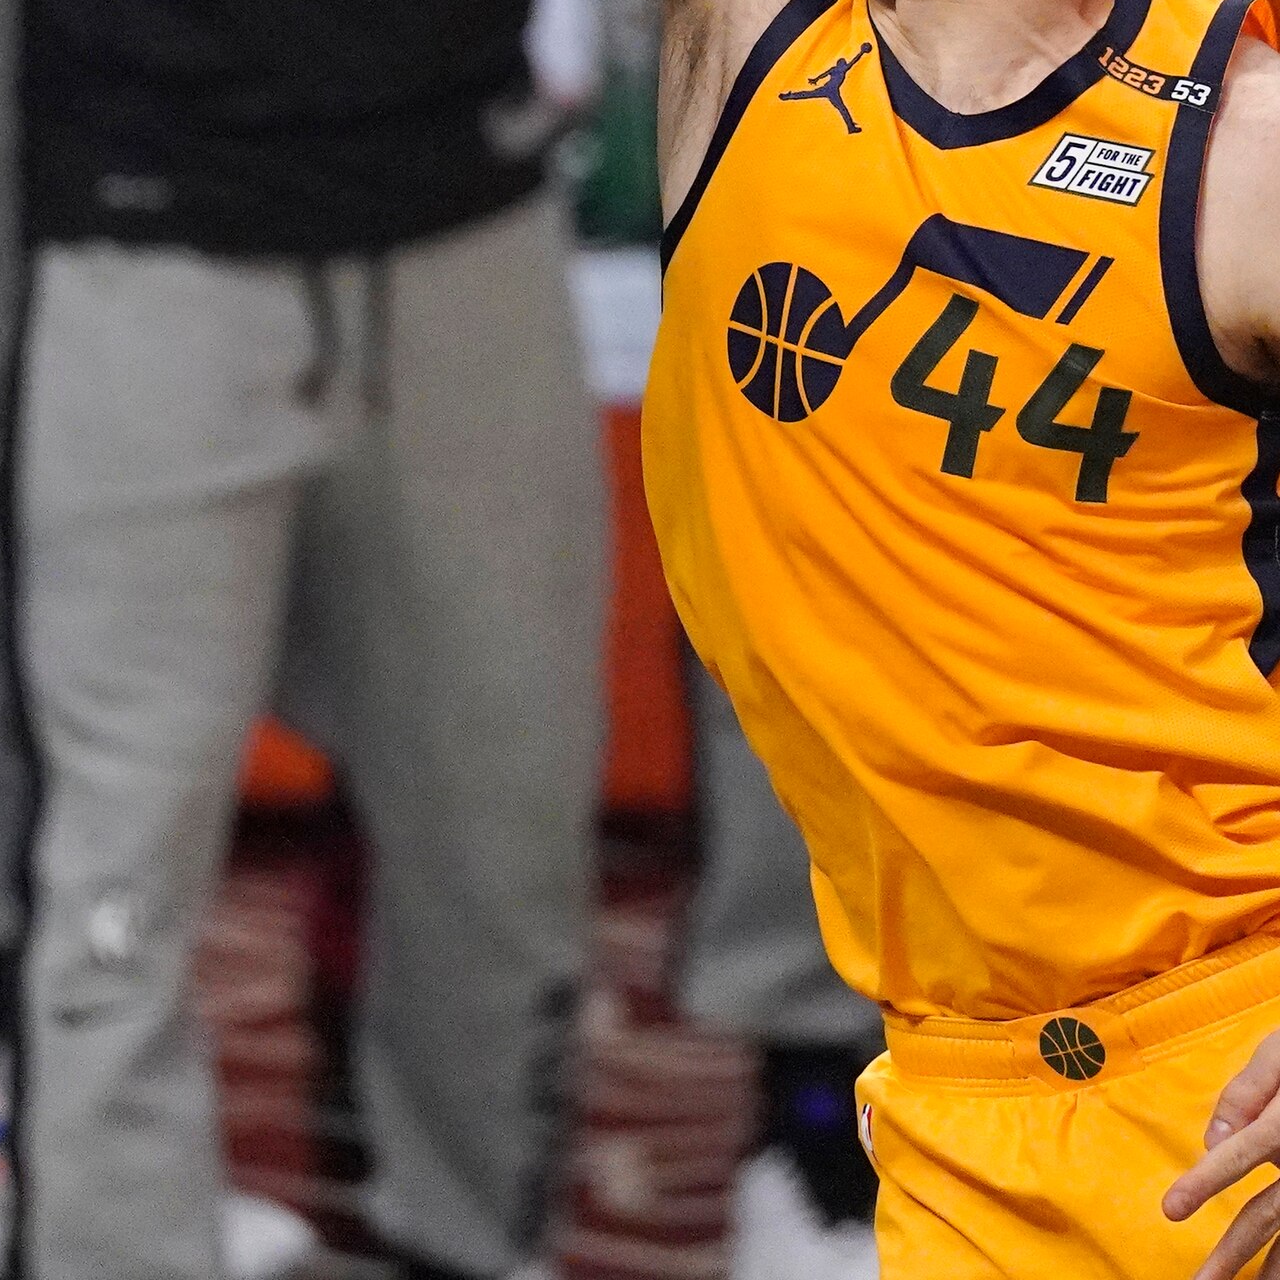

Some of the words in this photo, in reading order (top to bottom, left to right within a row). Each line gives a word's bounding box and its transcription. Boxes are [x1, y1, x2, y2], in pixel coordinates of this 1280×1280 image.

[1098, 46, 1166, 96] 1223
[1170, 79, 1212, 106] 53
[1045, 141, 1087, 182] 5
[1097, 148, 1120, 162] FOR
[1121, 152, 1143, 166] THE
[1076, 169, 1142, 197] FIGHT
[890, 293, 1140, 504] 44
